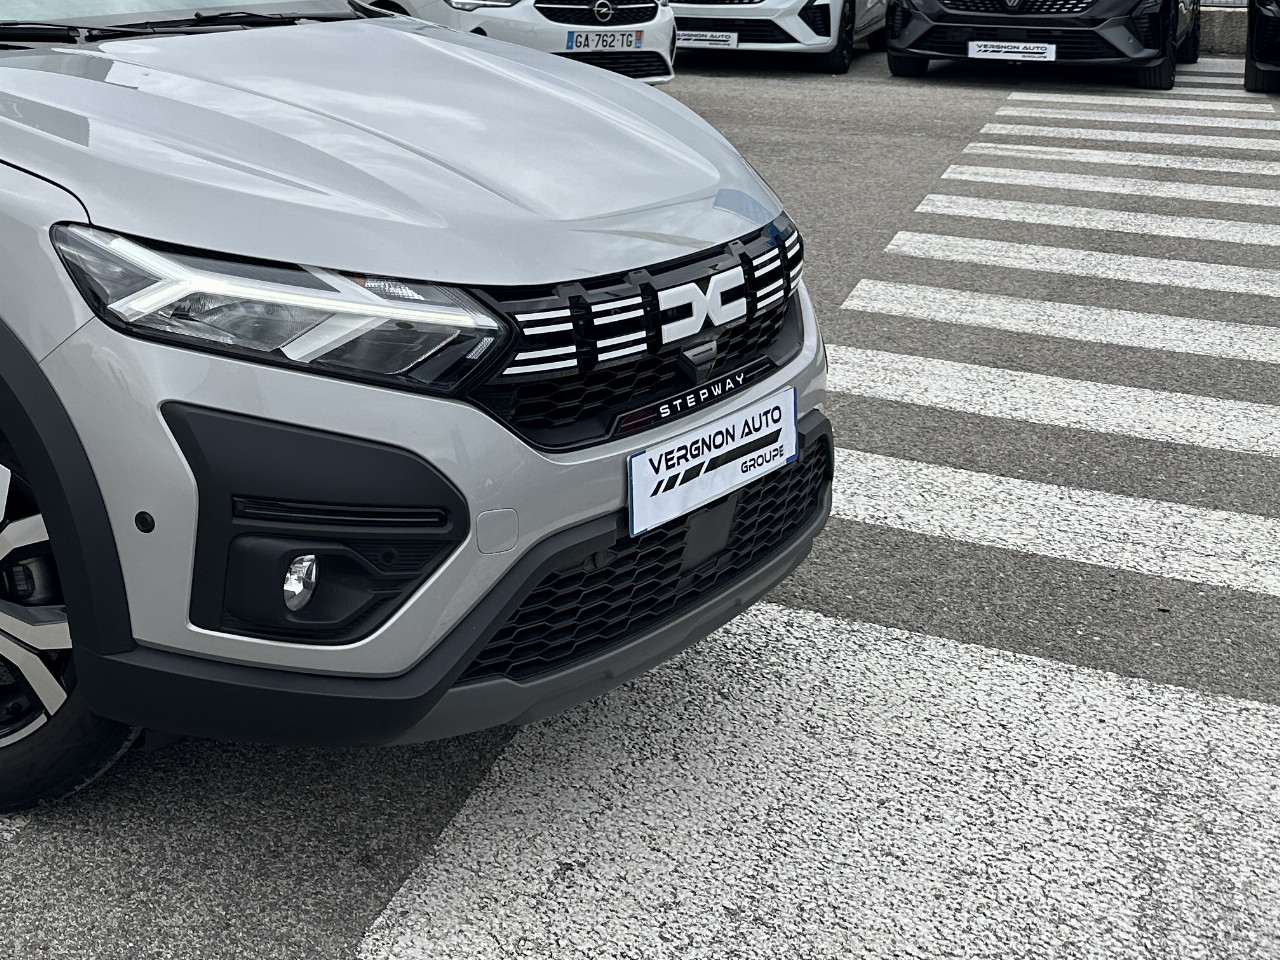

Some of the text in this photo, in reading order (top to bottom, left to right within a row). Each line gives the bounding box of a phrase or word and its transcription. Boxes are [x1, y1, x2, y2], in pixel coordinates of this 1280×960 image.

[659, 373, 745, 418] STEPWAY
[648, 404, 783, 476] VERGNON AUTO
[740, 444, 785, 474] GROUPE
